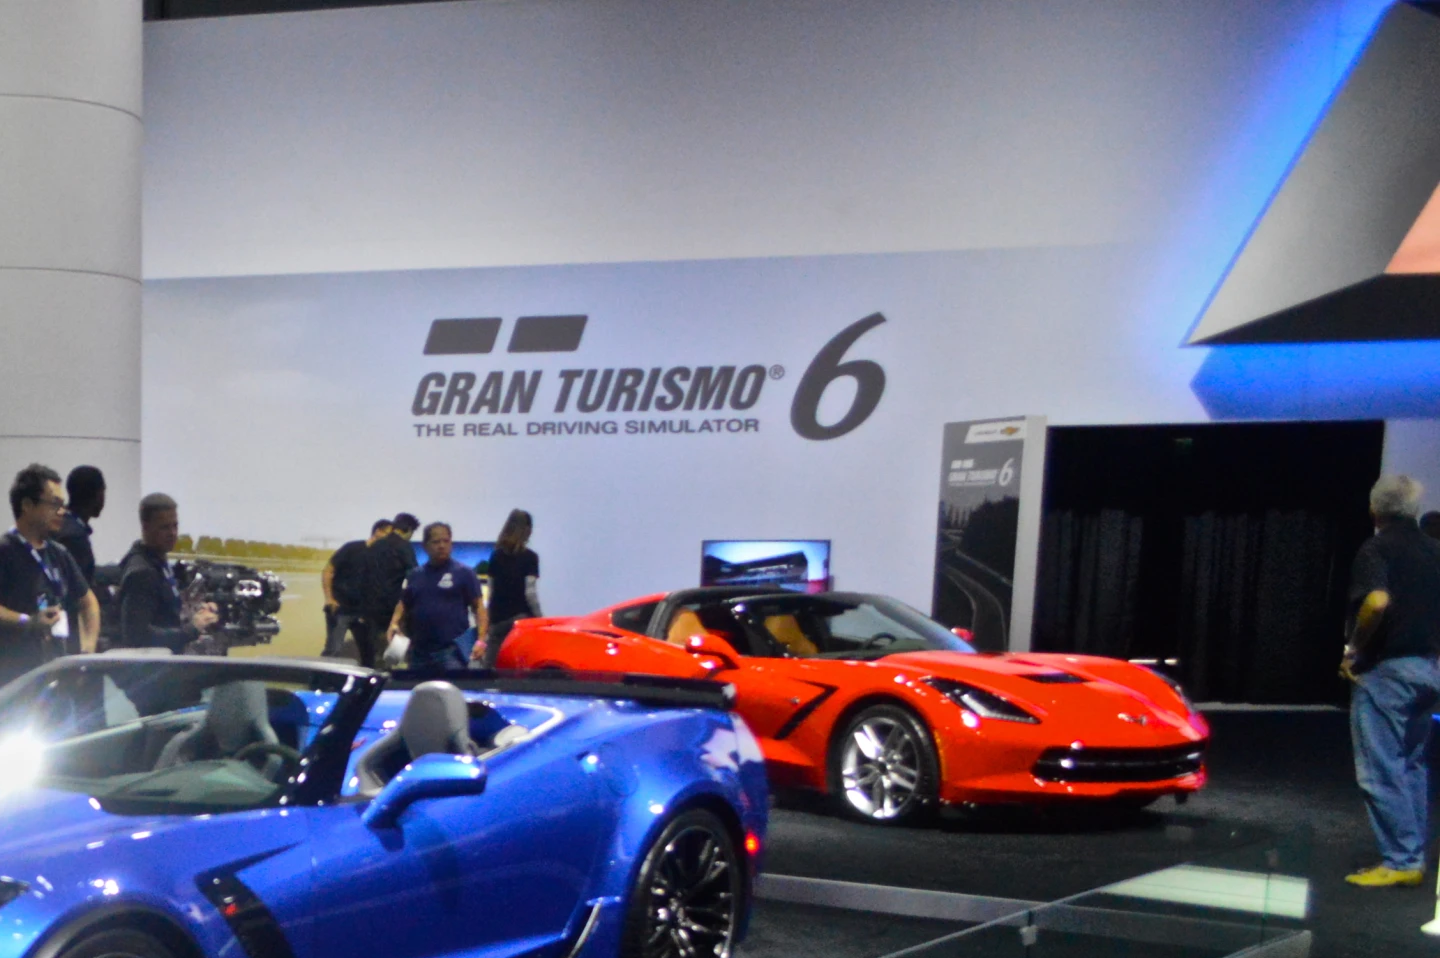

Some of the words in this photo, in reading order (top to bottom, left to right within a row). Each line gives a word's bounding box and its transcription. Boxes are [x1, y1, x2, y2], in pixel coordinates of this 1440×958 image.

[411, 370, 543, 416] GRAN
[790, 311, 887, 441] 6
[413, 423, 455, 437] THE
[462, 422, 519, 436] REAL
[526, 420, 619, 436] DRIVING
[624, 418, 760, 434] SIMULATOR
